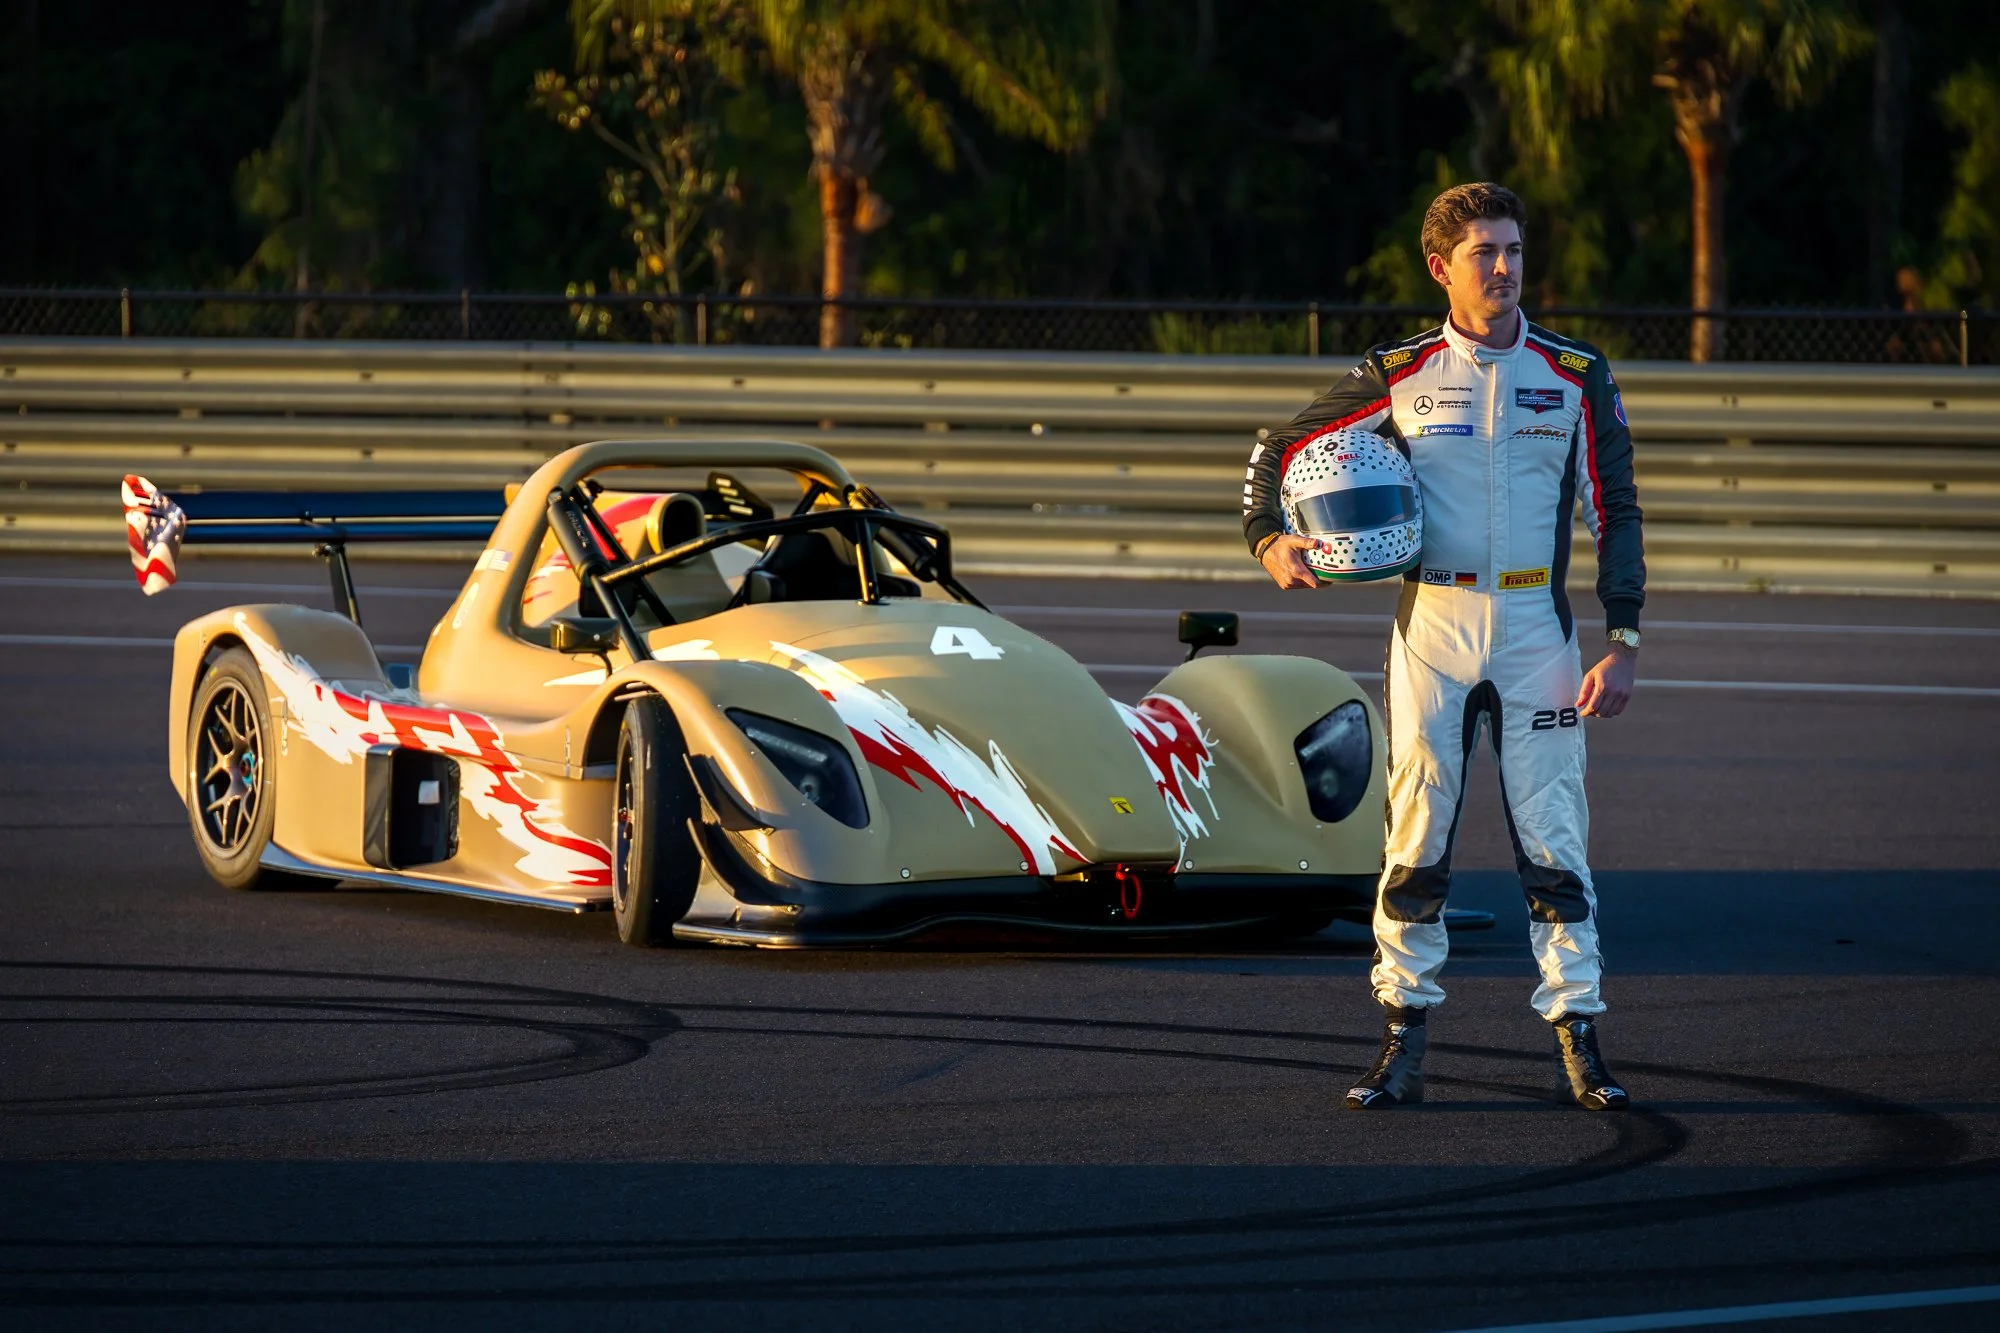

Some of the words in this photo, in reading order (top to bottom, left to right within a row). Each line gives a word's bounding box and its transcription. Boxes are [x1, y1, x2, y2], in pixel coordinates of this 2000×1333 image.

[1383, 352, 1412, 367] OMP
[1560, 354, 1588, 369] OMP
[1337, 453, 1361, 461] BELL
[1425, 571, 1452, 584] OMP
[1504, 571, 1545, 586] PIRELLI
[930, 626, 1006, 660] 4
[1531, 707, 1578, 731] 28
